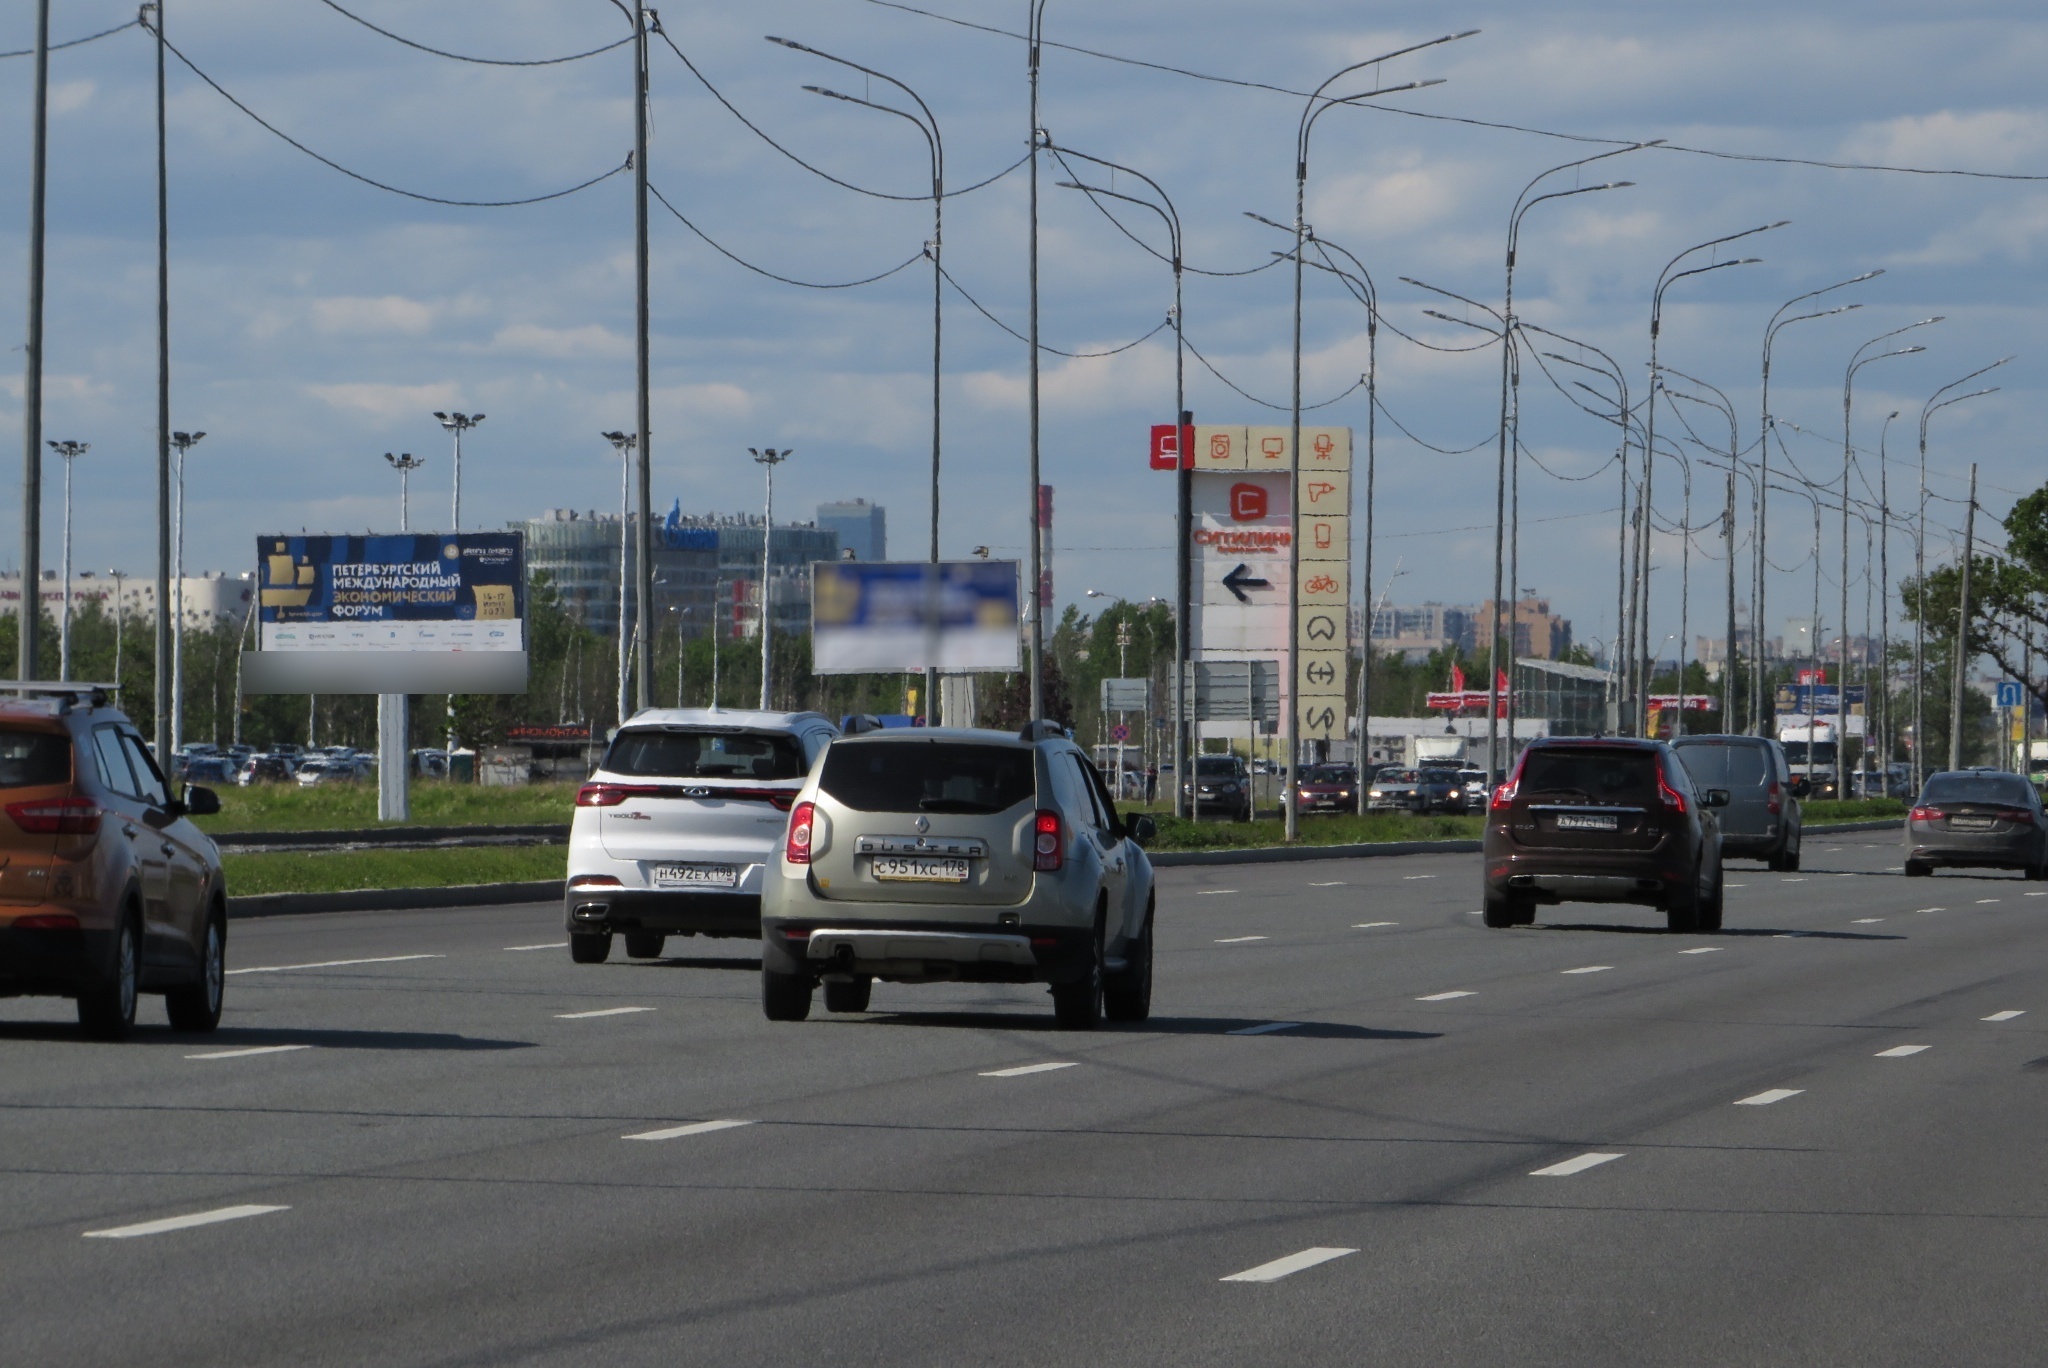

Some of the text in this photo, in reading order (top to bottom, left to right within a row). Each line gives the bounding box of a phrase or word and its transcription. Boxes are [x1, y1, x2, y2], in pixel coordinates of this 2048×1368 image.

[332, 561, 441, 576] ПЕТЕРБУРГСКИЙ
[333, 574, 461, 589] МЕЖДУНАРОДНЫЙ
[333, 588, 457, 603] ЭКОНОМИЧЕСКИЙ
[332, 605, 383, 616] ФОРУМ
[861, 843, 982, 855] DUSTER
[659, 866, 733, 880] Н492ЕХ 198
[877, 859, 965, 876] С951ХС 178
